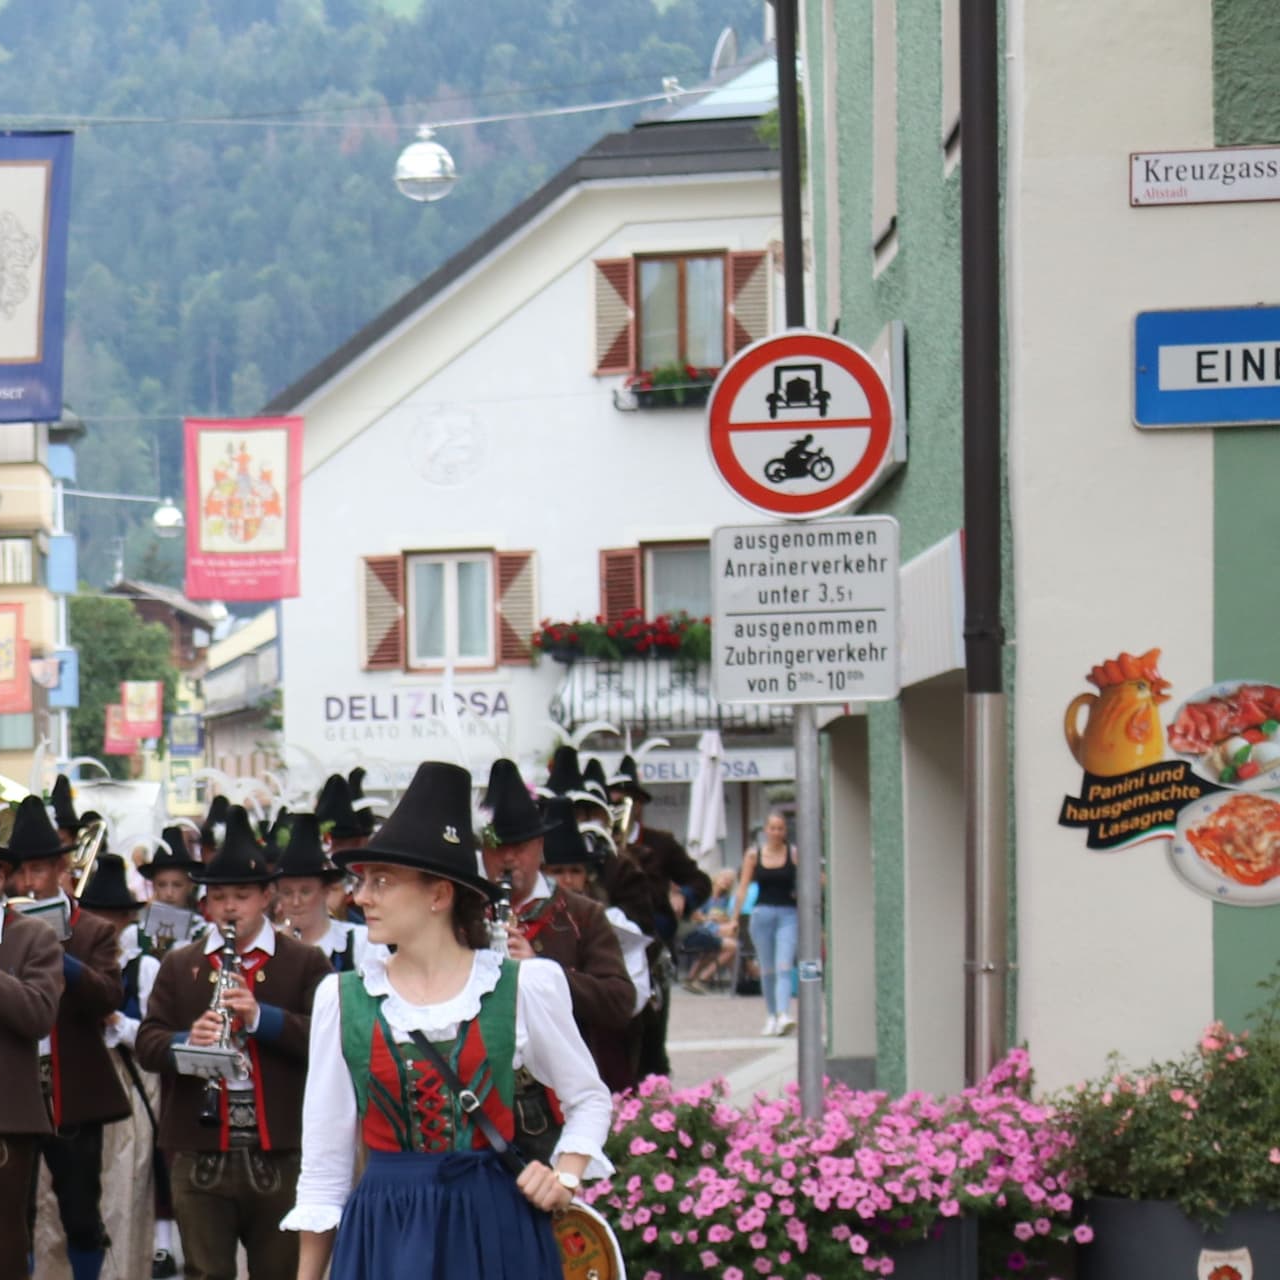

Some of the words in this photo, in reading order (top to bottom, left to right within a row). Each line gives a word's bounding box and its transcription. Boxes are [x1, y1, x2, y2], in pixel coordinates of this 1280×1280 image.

[1143, 158, 1280, 186] Kreuzgass
[1196, 347, 1280, 384] EIN
[733, 530, 877, 554] ausgenommen
[724, 554, 888, 578] Anrainerverkehr
[758, 585, 809, 605] unter
[734, 618, 878, 642] ausgenommen
[725, 642, 888, 669] Zubringerverkehr
[747, 676, 779, 693] von
[324, 723, 400, 741] GELATO
[1089, 773, 1146, 801] Panini
[1148, 764, 1185, 785] und
[1065, 784, 1202, 821] hausgemachte
[1098, 808, 1176, 839] Lasagne
